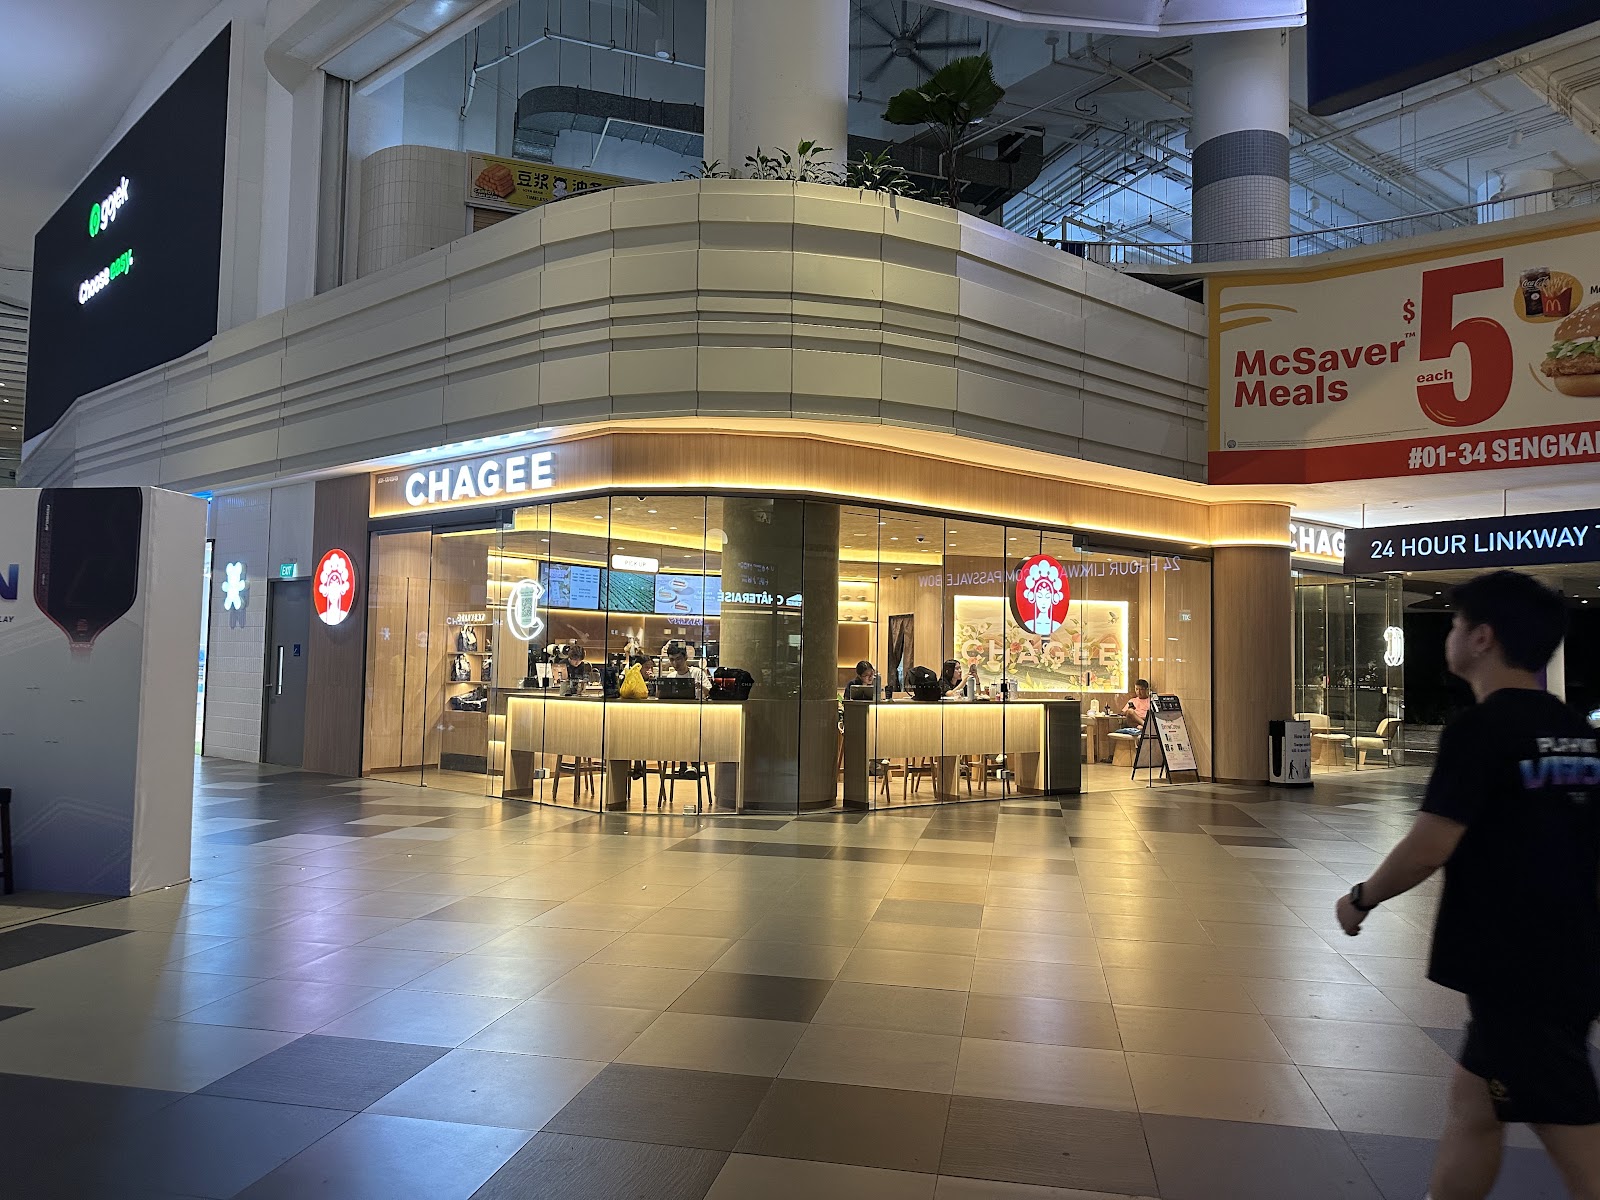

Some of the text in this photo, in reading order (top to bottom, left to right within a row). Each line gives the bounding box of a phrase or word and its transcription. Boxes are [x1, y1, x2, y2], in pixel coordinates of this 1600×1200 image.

[516, 170, 549, 190] 豆浆
[100, 176, 130, 231] gojek
[79, 266, 110, 305] Choose
[1234, 375, 1349, 408] Meals
[1416, 368, 1454, 384] each
[1408, 441, 1487, 470] #01-34
[405, 451, 554, 507] CHAGEE
[1370, 525, 1588, 559] 24 HOUR LINKWAY
[281, 565, 293, 577] EXIT
[961, 638, 1118, 667] CHAGEE
